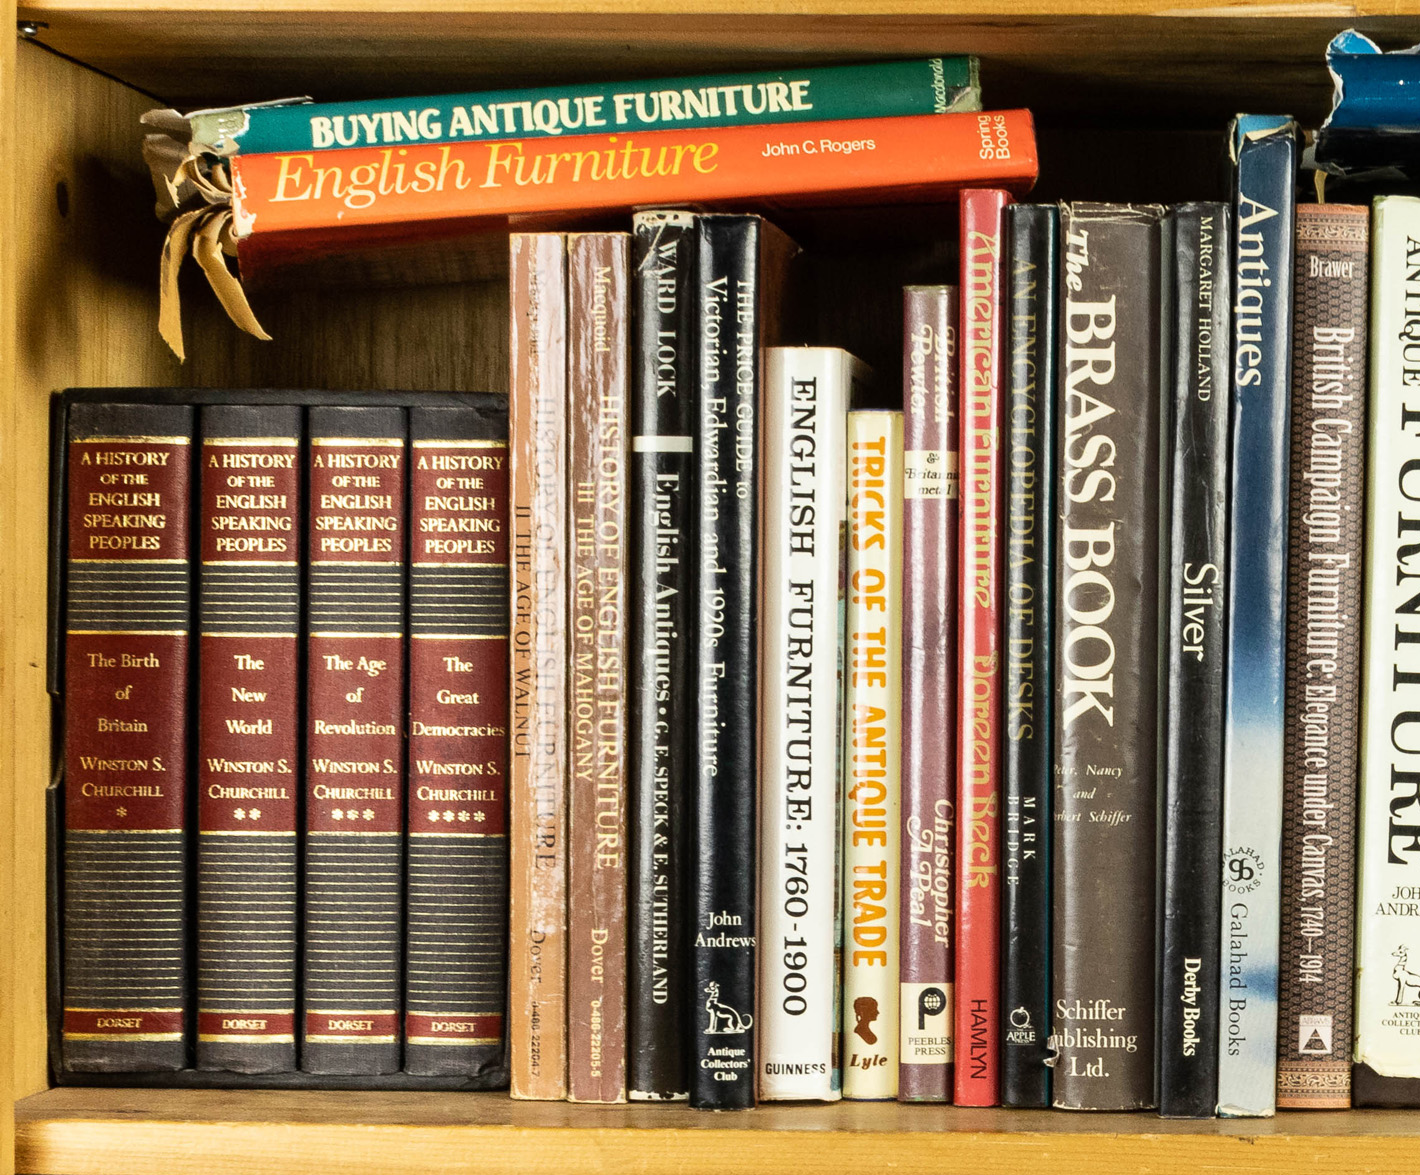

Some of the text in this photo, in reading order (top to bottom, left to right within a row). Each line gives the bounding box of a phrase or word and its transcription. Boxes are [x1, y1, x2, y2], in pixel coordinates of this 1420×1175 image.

[310, 80, 812, 147] BUYING ANTIQUE FURNITURE
[761, 136, 875, 157] John C. Rogers
[976, 115, 994, 160] Spring
[994, 114, 1010, 160] Books
[270, 139, 718, 204] English Furniture
[1310, 256, 1355, 279] Brawer
[1235, 193, 1279, 386] Antiques
[1198, 216, 1214, 401] MARGARET HOLLAND
[82, 453, 169, 465] A HISTORY
[1063, 230, 1116, 730] The BRASS BOOK
[89, 494, 160, 507] ENGLISH
[84, 515, 165, 528] SPEAKING
[89, 535, 160, 550] PEOPLES
[786, 376, 817, 829] ENGLISH FURNITURE:
[1183, 562, 1206, 661] Silver
[87, 654, 159, 667] The Birth
[98, 719, 147, 733] Britain
[79, 757, 166, 771] WINSTON S.
[82, 783, 163, 797] CHURCHILL
[708, 912, 741, 927] John
[695, 934, 756, 948] Andrews
[1228, 903, 1248, 1058] Galahad Books
[1180, 957, 1202, 1057] Derby Books
[97, 1018, 141, 1028] DORSET
[970, 999, 988, 1079] HAMLYN
[765, 1062, 826, 1075] GUINNESS
[850, 1052, 887, 1069] Lyle
